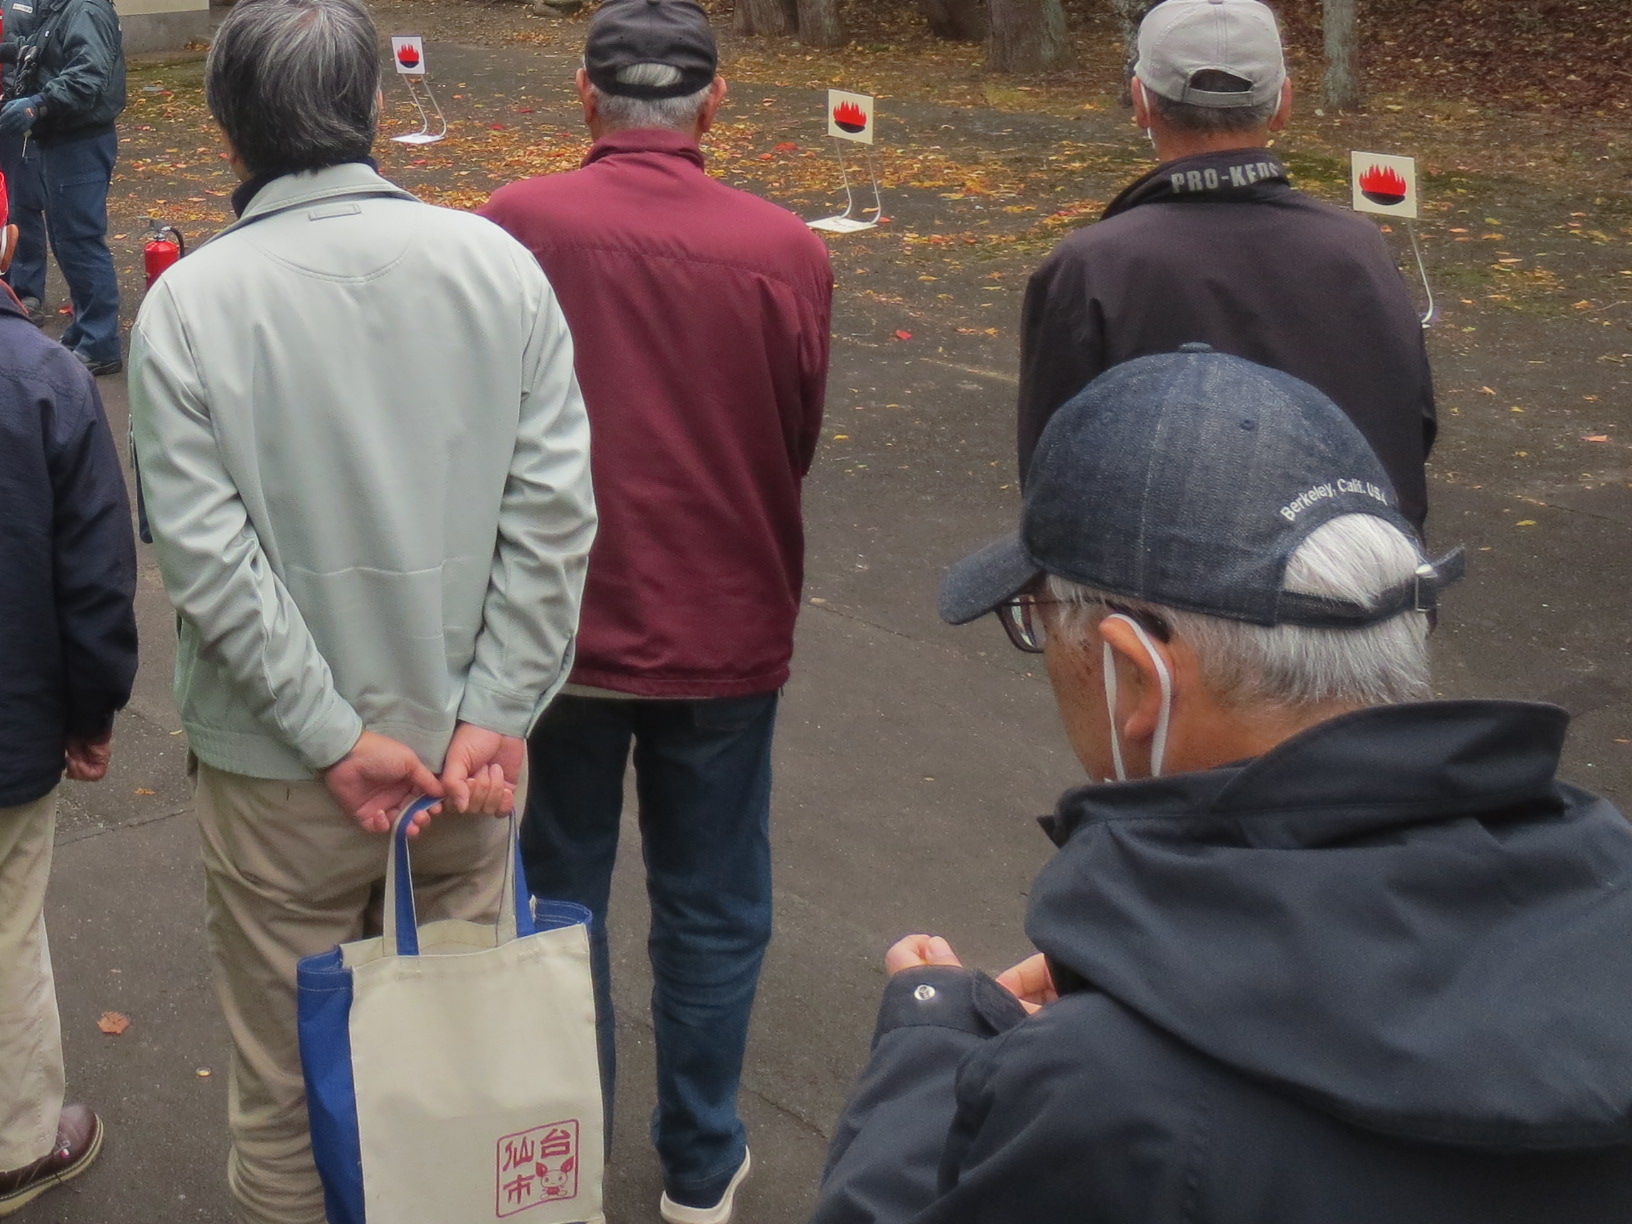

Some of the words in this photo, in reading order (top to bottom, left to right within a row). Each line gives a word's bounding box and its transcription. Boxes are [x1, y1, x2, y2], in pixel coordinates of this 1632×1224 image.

[1279, 482, 1337, 521] Berkeley,
[1336, 478, 1366, 494] Calif.
[502, 1173, 536, 1205] 市
